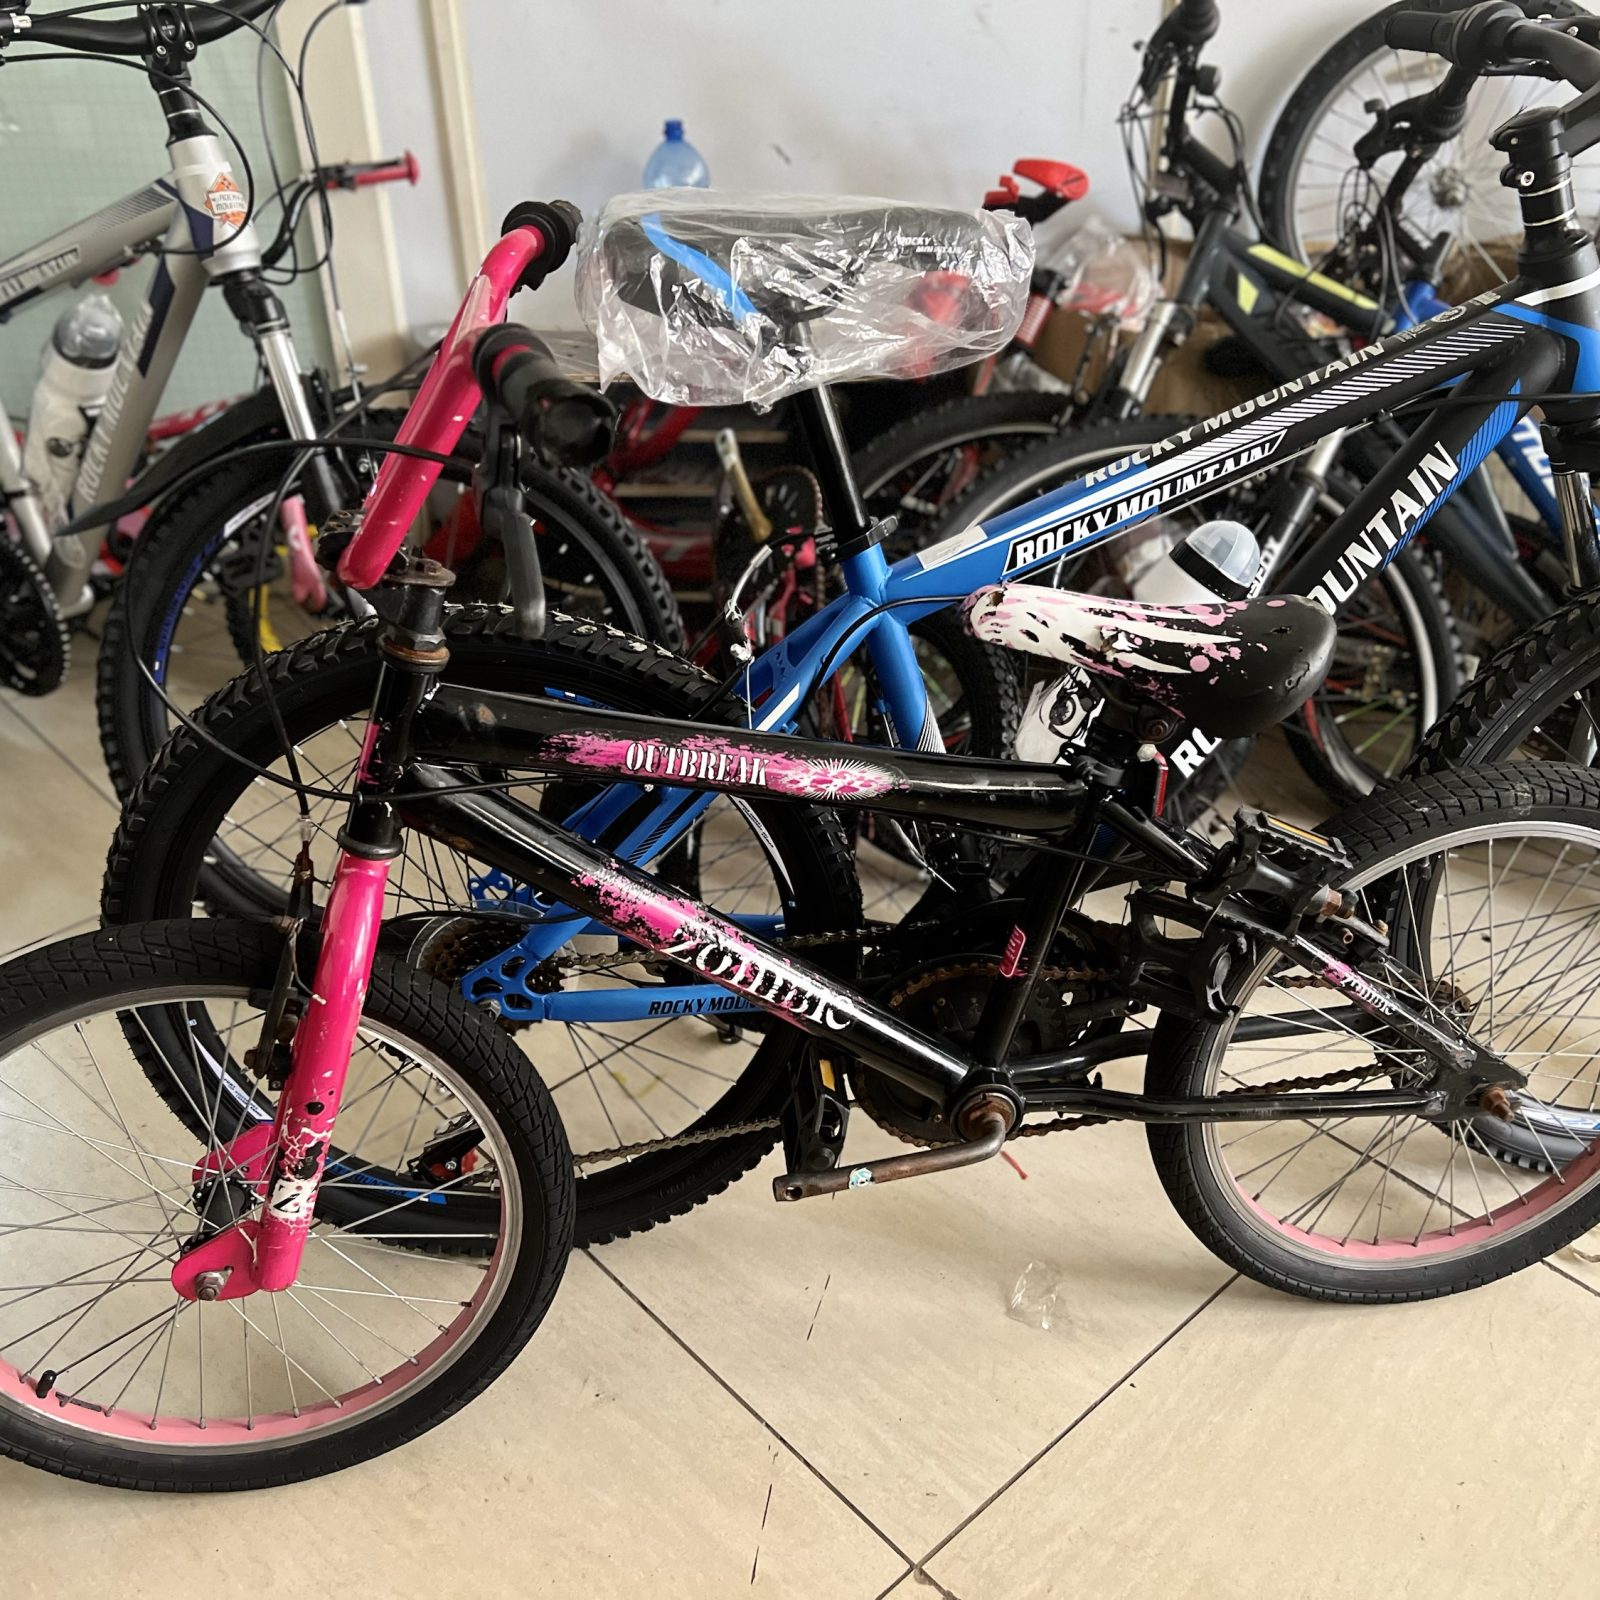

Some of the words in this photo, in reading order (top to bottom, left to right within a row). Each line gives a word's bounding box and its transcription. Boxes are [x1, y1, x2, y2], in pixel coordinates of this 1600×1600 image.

[1085, 425, 1194, 489] ROCKY
[1203, 341, 1386, 434] MOUNTAIN
[1014, 507, 1114, 568] ROCKY
[1116, 440, 1272, 521] MOUNTAIN
[625, 742, 769, 787] OUTBREAK
[648, 998, 707, 1016] ROCKY
